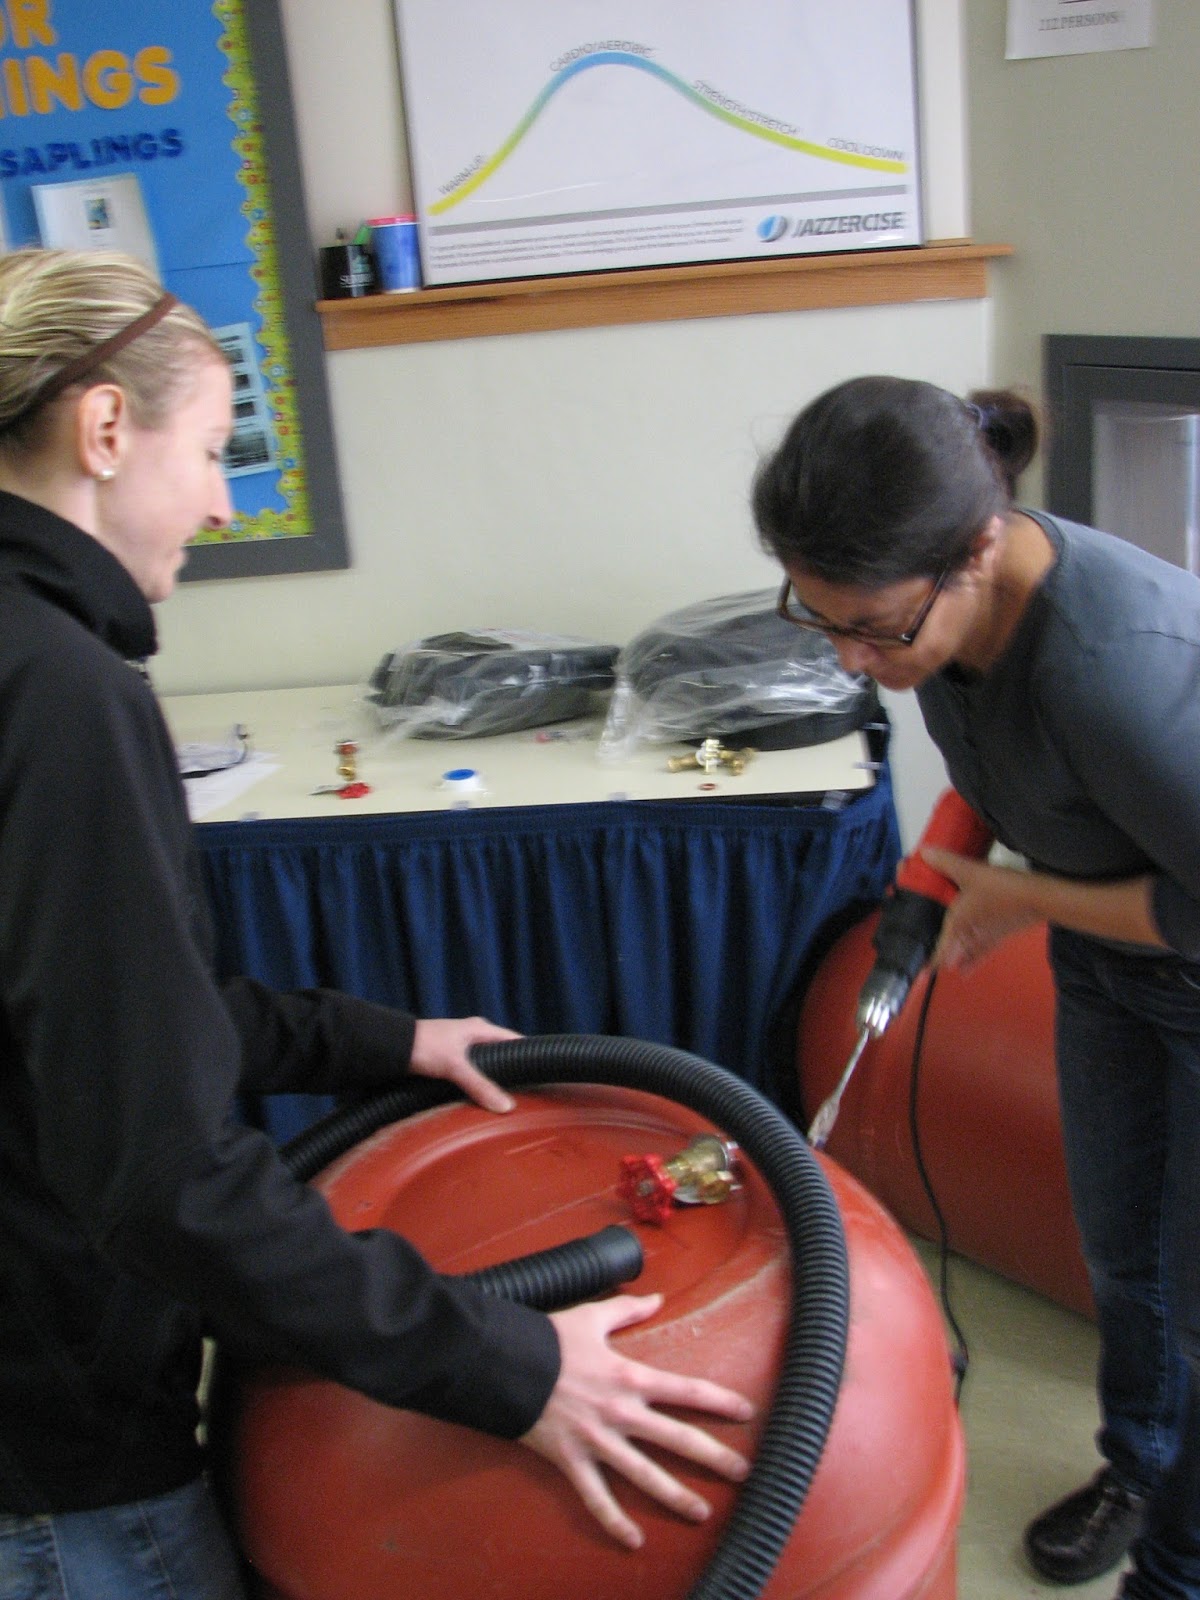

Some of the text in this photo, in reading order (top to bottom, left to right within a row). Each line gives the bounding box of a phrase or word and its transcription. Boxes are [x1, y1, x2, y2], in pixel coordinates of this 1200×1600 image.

[0, 0, 58, 49] R
[1061, 11, 1122, 29] PERSONS
[0, 46, 181, 118] INGS
[0, 128, 183, 177] SAPLINGS
[792, 212, 906, 238] JAZZERCISE
